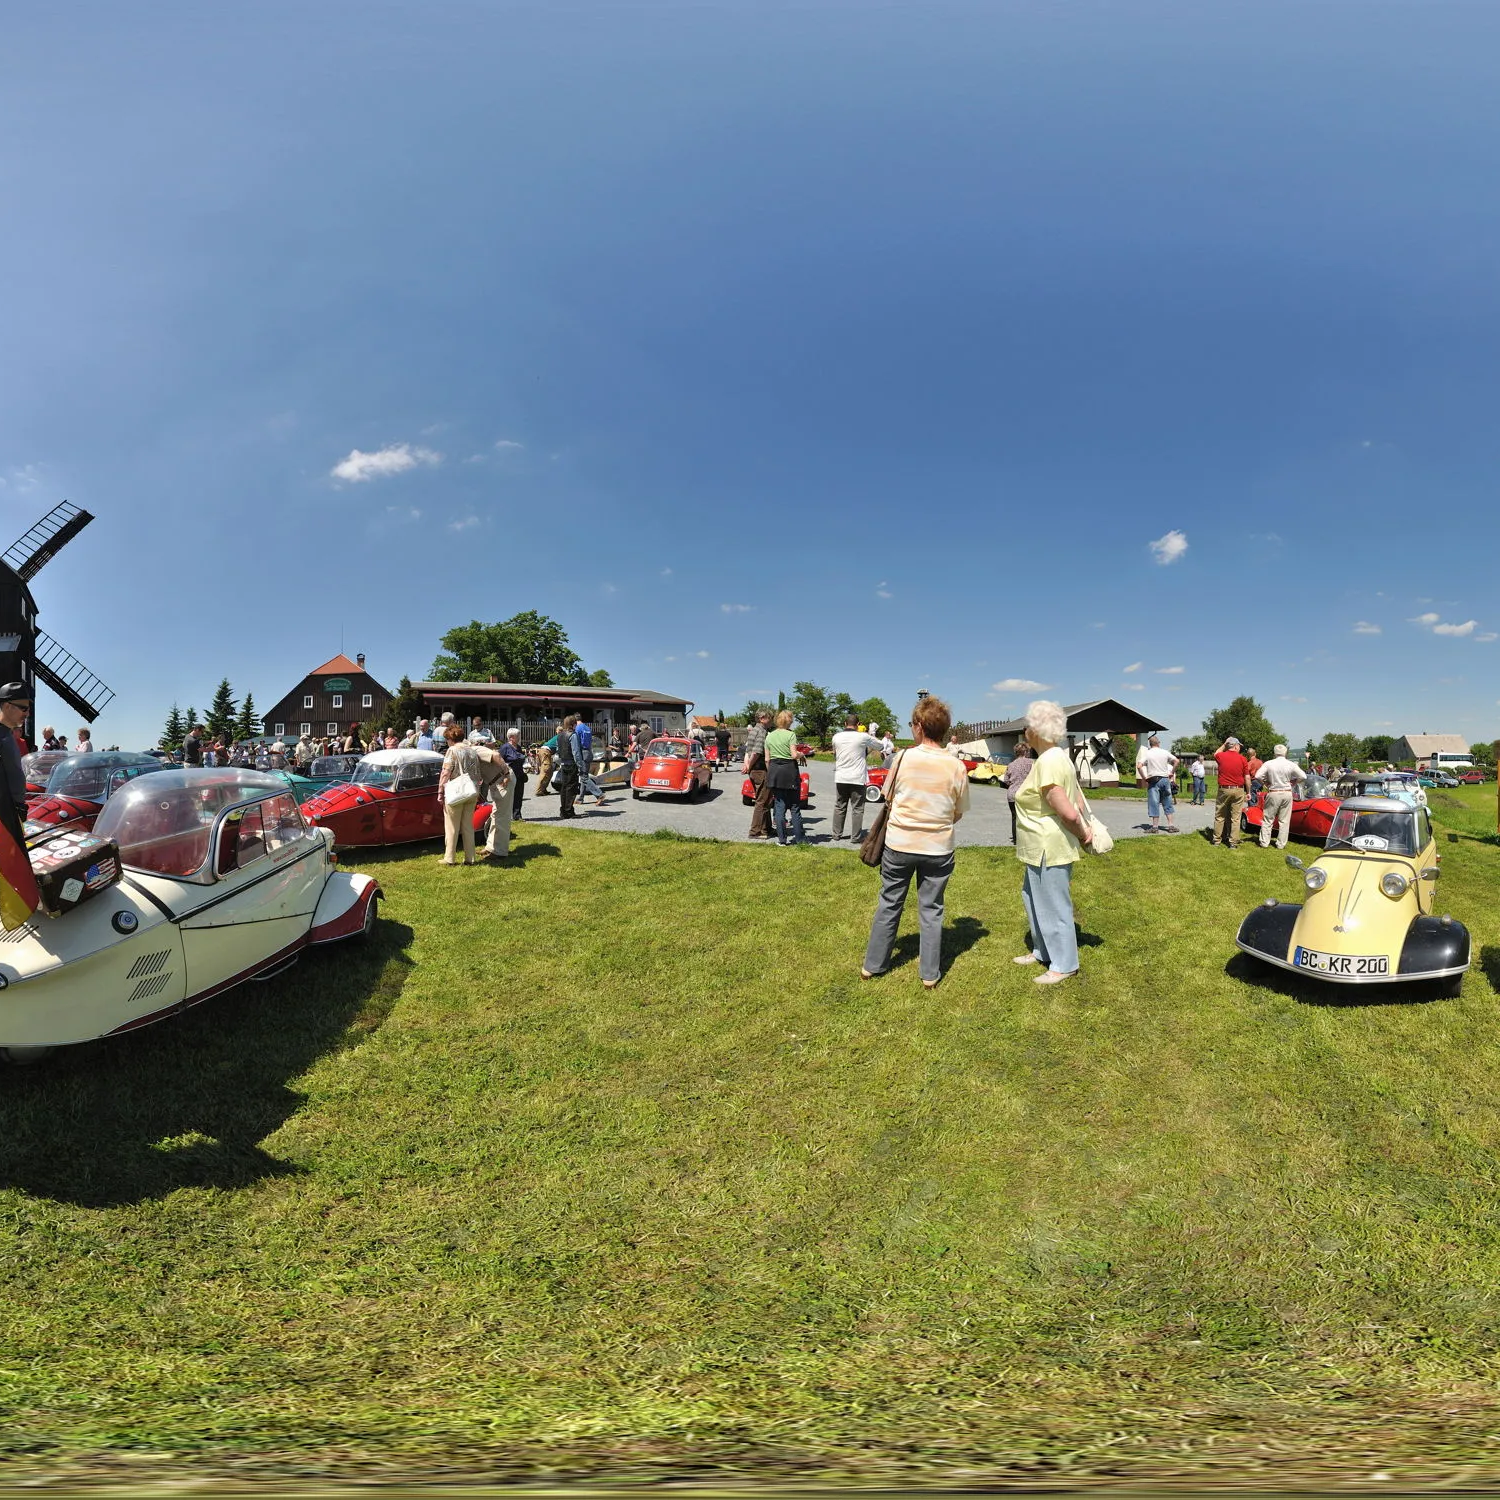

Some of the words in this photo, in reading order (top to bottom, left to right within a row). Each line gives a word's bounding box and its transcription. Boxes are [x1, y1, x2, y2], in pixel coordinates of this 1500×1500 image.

[1300, 950, 1317, 968] BC
[1329, 956, 1351, 973] KR
[1357, 958, 1387, 974] 200
